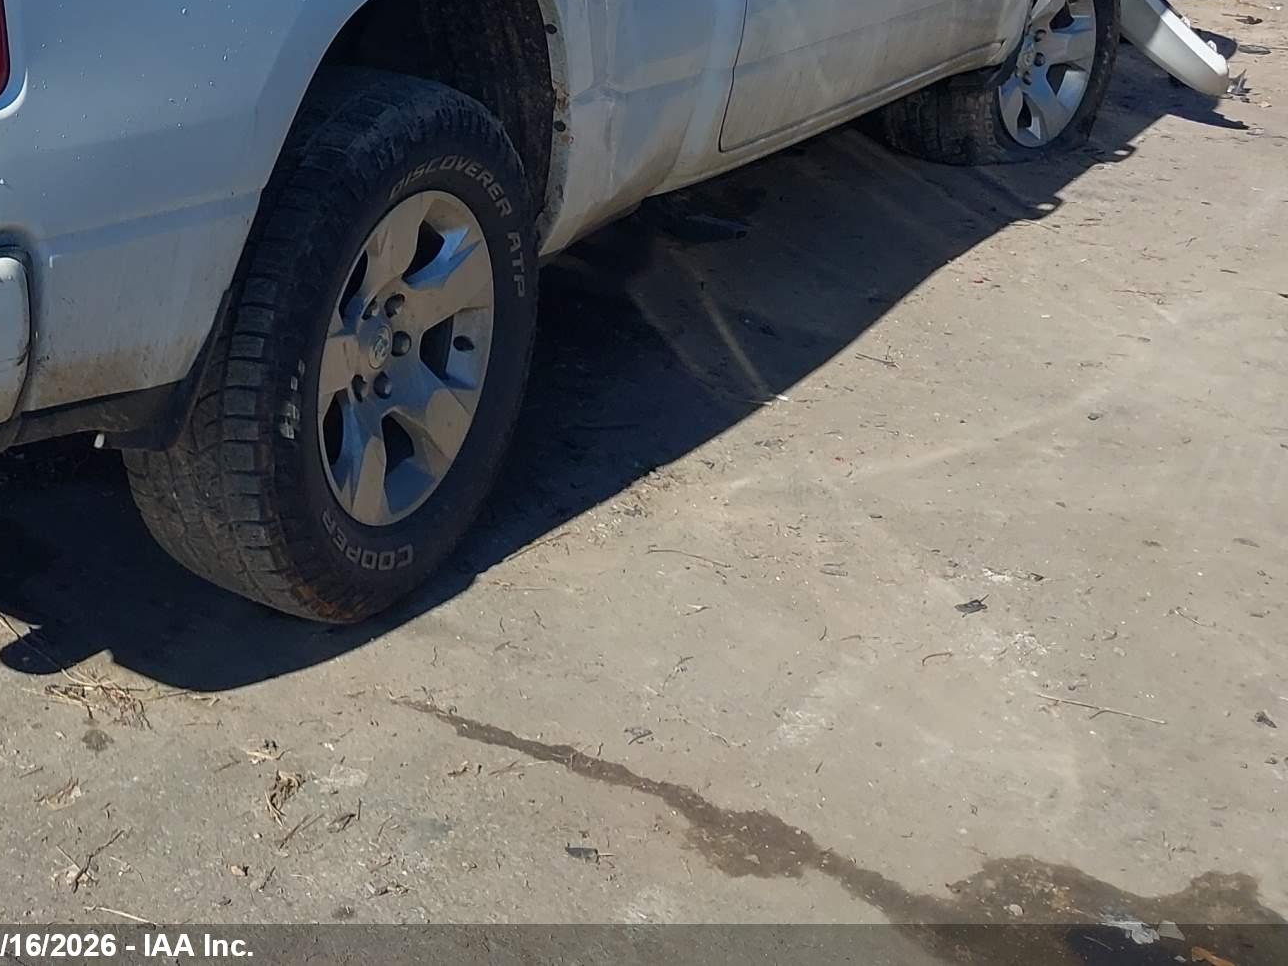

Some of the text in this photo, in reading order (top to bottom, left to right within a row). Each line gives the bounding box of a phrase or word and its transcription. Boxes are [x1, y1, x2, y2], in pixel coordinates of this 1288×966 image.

[389, 154, 525, 297] DISCOVERER ATP
[321, 508, 414, 571] COOPER
